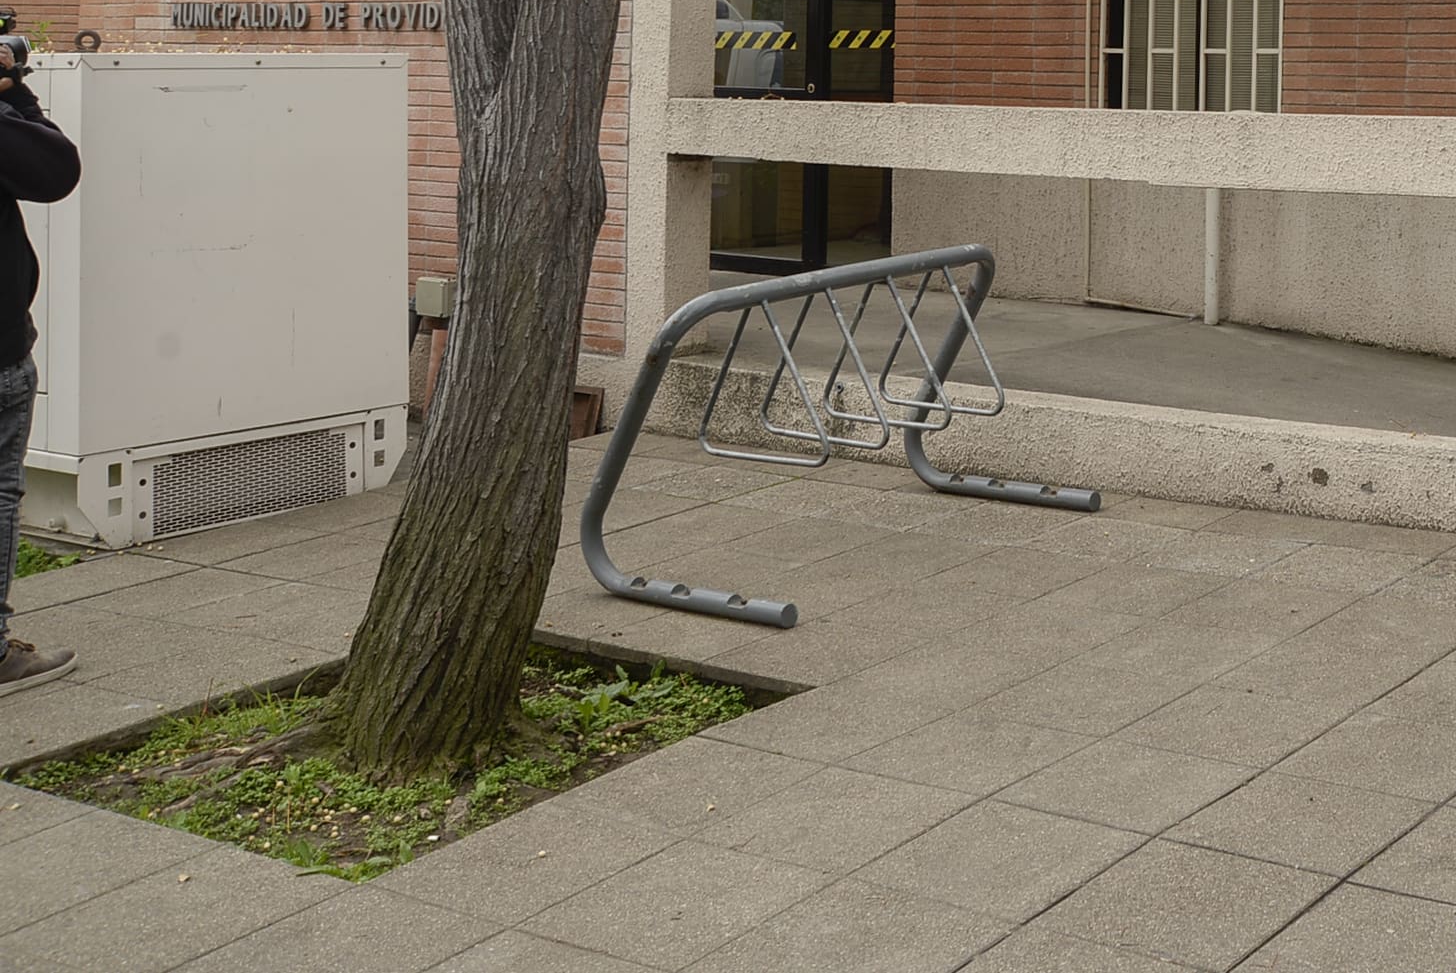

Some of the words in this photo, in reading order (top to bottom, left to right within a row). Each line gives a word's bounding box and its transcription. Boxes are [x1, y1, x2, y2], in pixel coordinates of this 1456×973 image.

[171, 3, 309, 28] MUNICIPALIDAD
[322, 3, 348, 28] DE
[361, 3, 444, 29] PROVID
